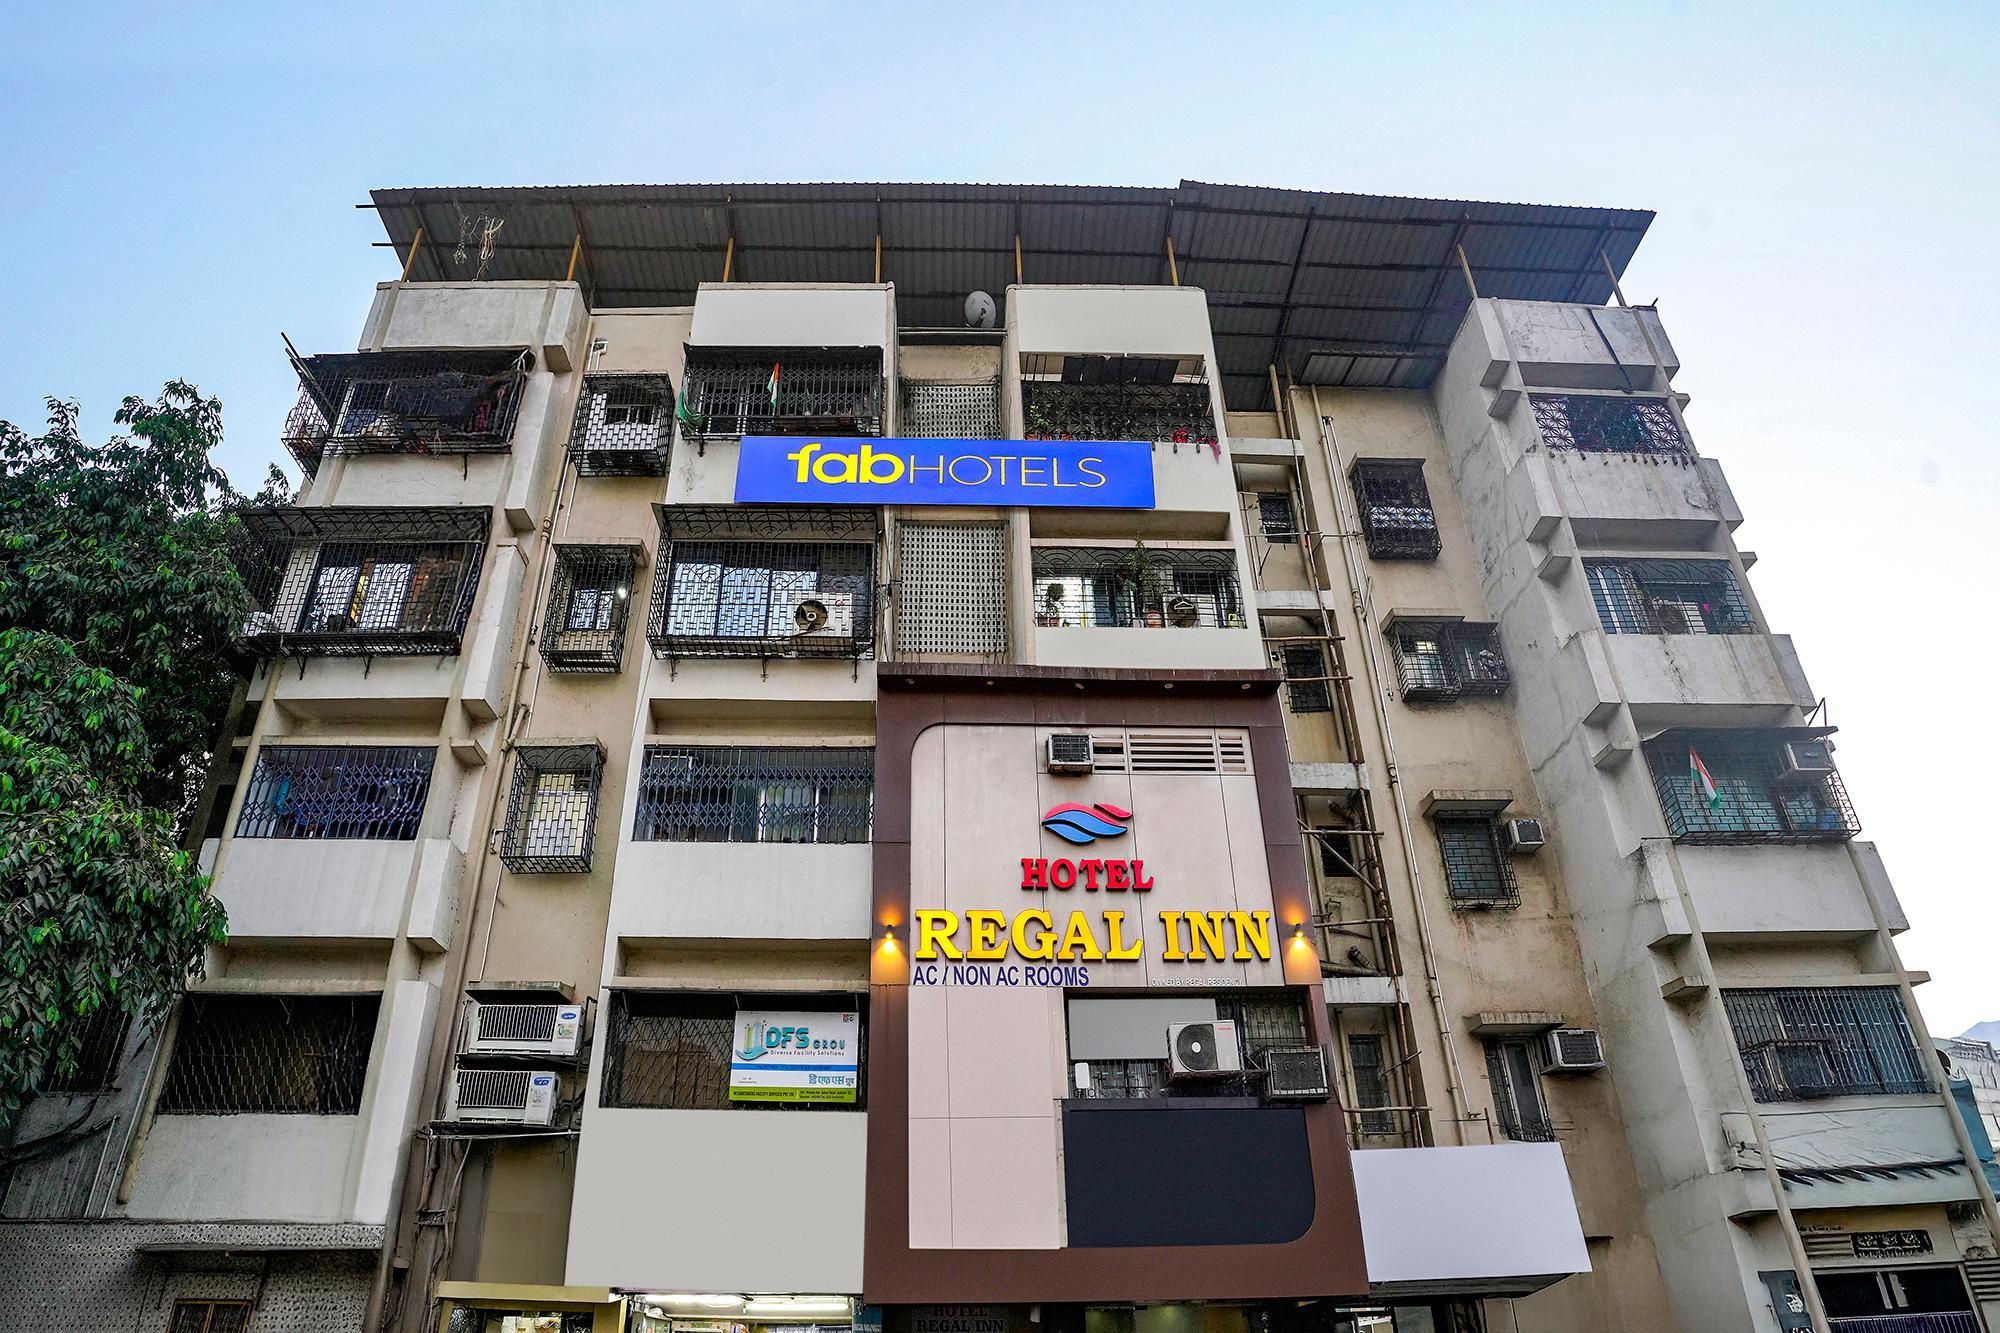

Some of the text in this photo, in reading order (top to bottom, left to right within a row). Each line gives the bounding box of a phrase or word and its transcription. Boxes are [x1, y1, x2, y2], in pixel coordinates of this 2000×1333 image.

[1021, 858, 1155, 891] HOTEL
[914, 908, 1271, 963] REGAL INN
[912, 966, 938, 986] AC
[952, 966, 991, 986] NON
[995, 966, 1020, 986] AC
[1024, 966, 1090, 987] ROOMS
[1186, 978, 1206, 986] REGAL
[1208, 978, 1243, 986] RESIDENCY
[766, 1026, 810, 1049] DFS
[933, 1306, 988, 1318] HOTEL
[916, 1319, 1005, 1333] REGAL INN
